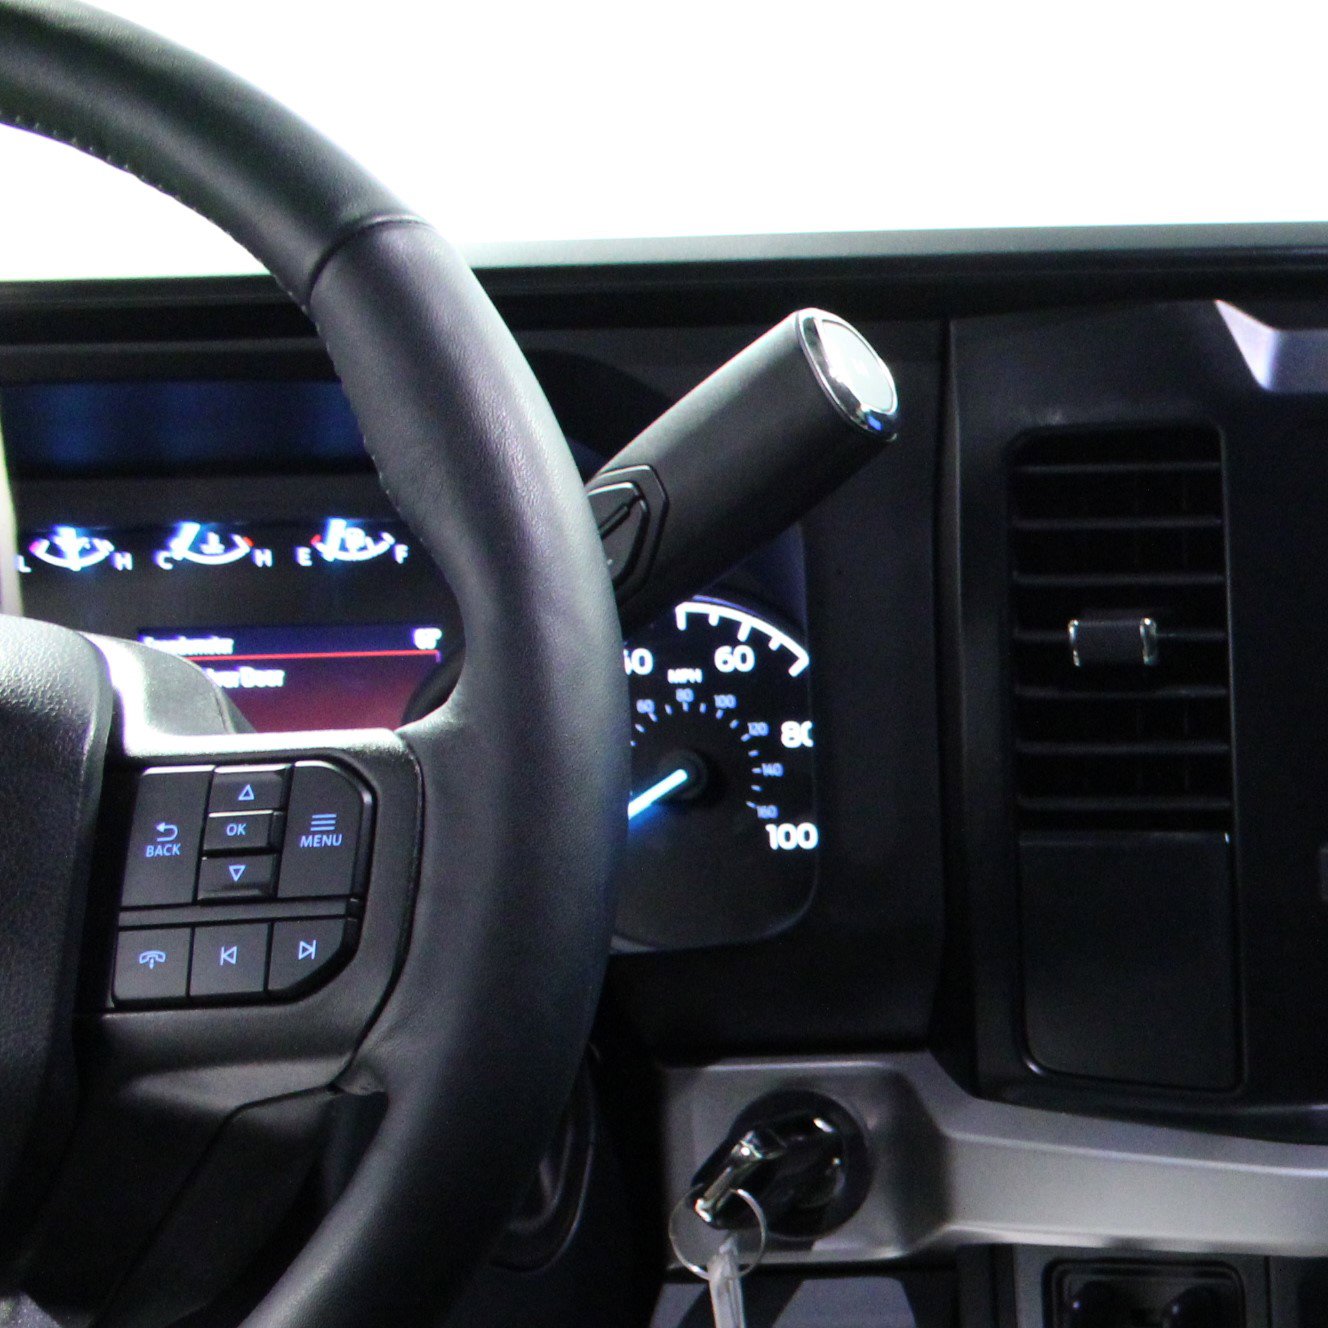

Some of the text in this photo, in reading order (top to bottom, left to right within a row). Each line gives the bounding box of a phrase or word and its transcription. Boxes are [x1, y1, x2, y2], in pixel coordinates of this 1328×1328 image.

[714, 645, 755, 673] 60
[226, 823, 246, 836] OK
[766, 823, 818, 850] 100
[300, 834, 342, 848] MENU
[145, 843, 181, 857] BACK
